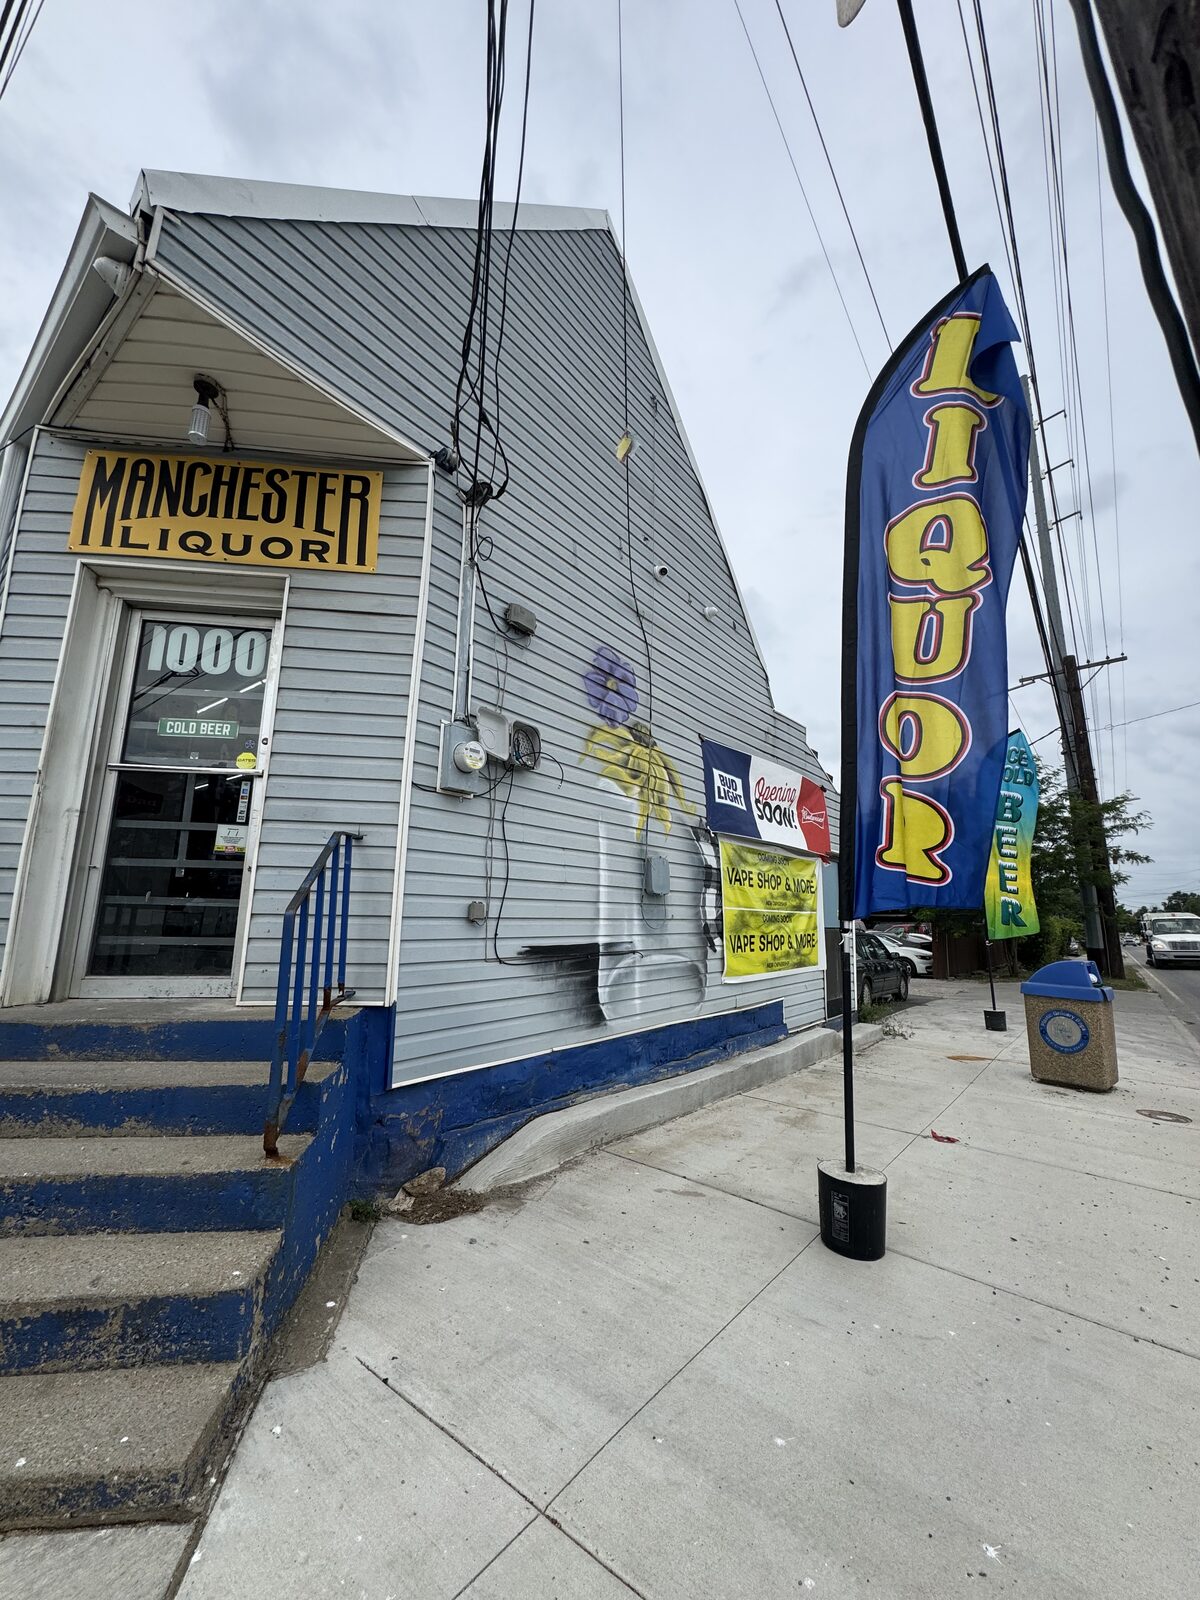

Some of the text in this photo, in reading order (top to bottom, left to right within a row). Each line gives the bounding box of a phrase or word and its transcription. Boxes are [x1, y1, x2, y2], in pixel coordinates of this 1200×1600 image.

[79, 456, 371, 566] MANCHESTER
[118, 525, 330, 564] LIQUOR
[877, 311, 1004, 885] LIQUOR
[148, 625, 267, 677] 1000
[166, 721, 231, 736] COLD BEER
[1007, 745, 1028, 768] CE
[718, 773, 738, 792] BUD
[1002, 764, 1035, 787] OLD
[717, 786, 743, 807] LIGHT
[754, 776, 797, 807] Opening
[754, 798, 798, 830] SOON!
[995, 790, 1028, 928] BEER
[726, 866, 816, 895] VAPE SHOP & MORE
[762, 913, 780, 924] COMING
[729, 932, 816, 954] VAPE SHOP & MORE
